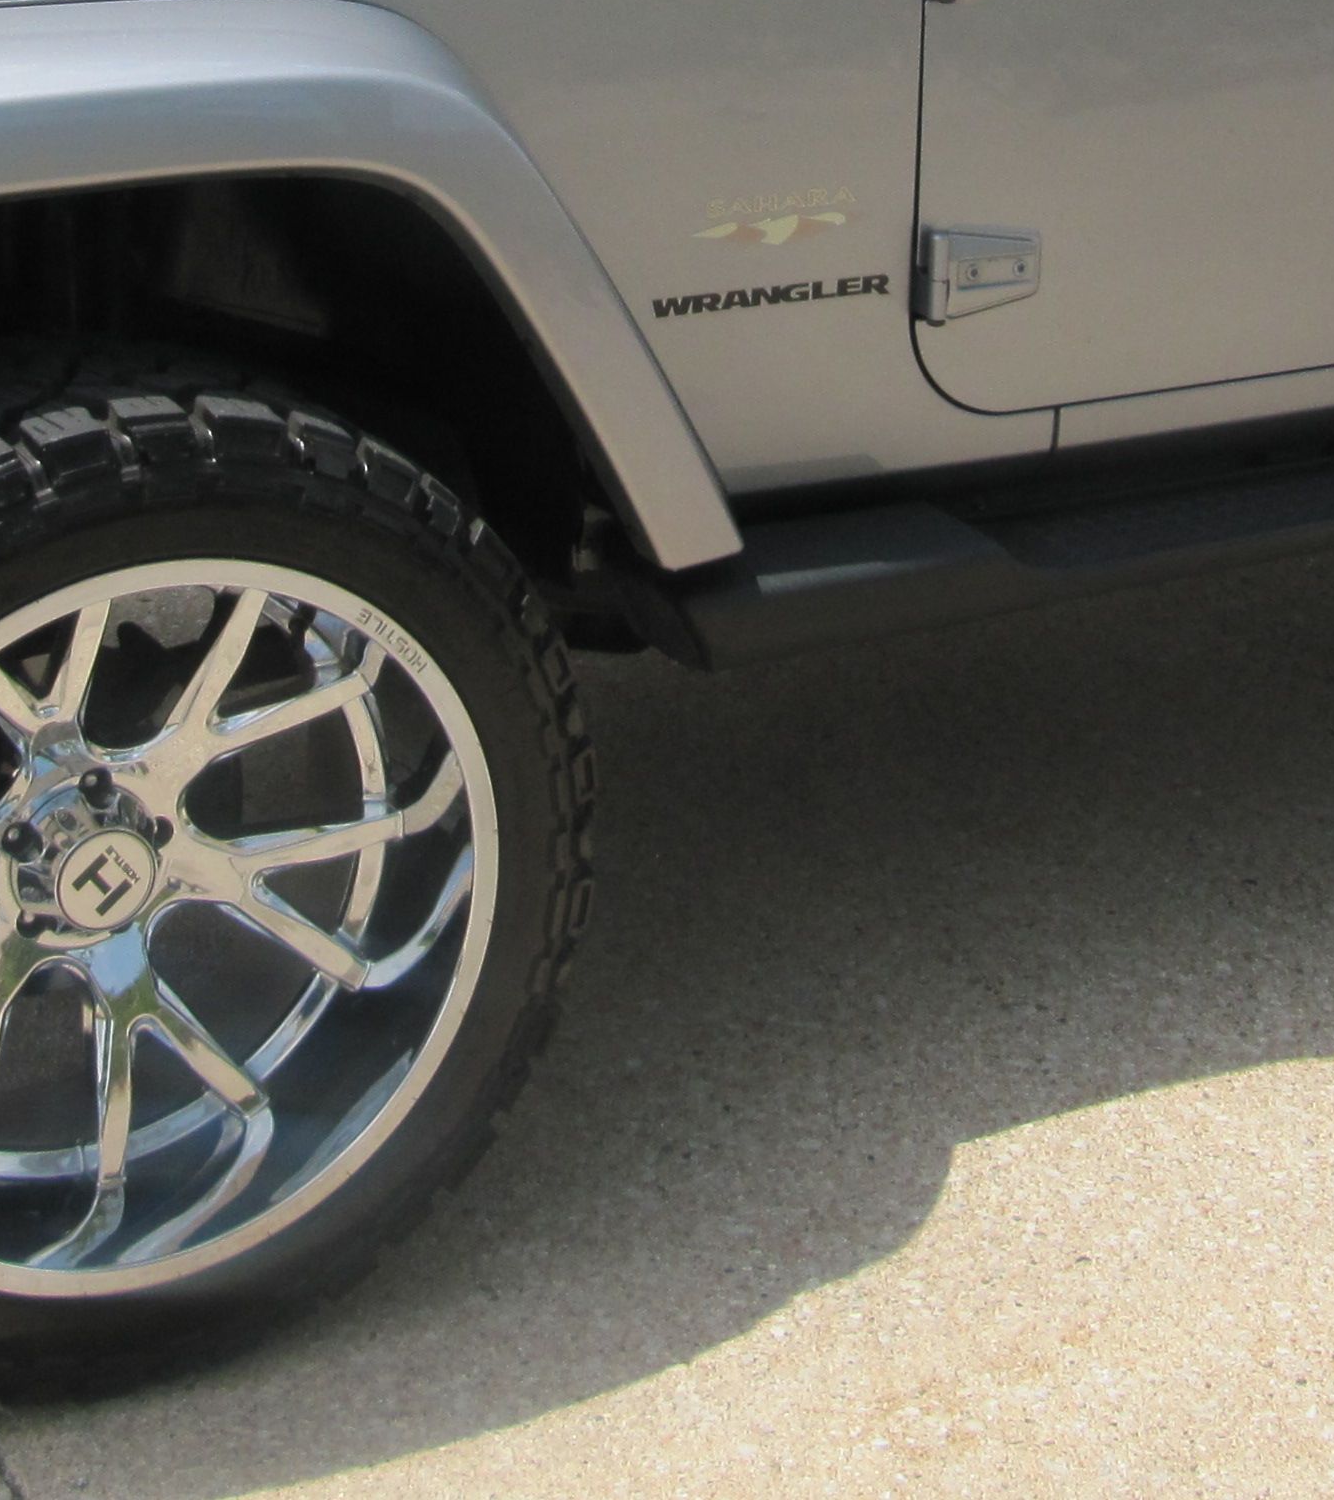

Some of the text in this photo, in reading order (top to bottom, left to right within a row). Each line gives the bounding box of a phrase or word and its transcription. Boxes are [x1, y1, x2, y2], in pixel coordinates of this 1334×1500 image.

[706, 185, 858, 217] SAHARA
[652, 273, 890, 318] WRANGLER
[355, 606, 429, 674] HOSTILE
